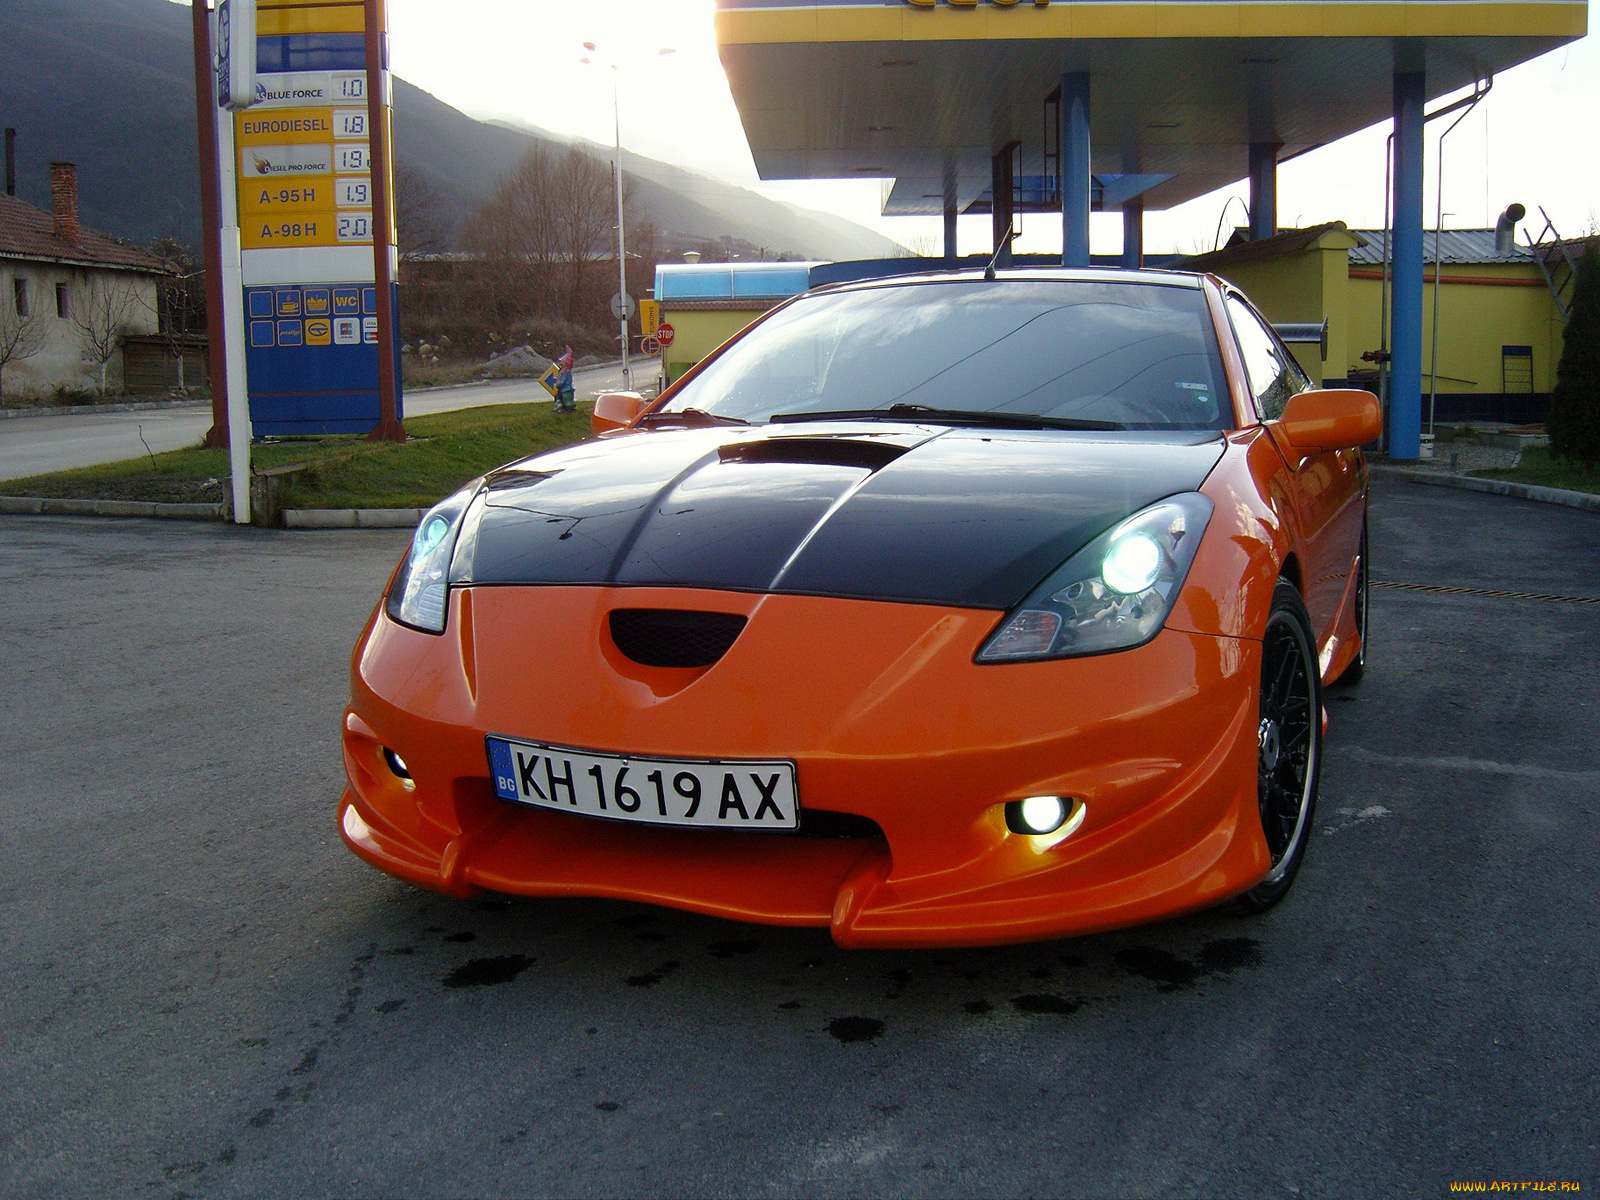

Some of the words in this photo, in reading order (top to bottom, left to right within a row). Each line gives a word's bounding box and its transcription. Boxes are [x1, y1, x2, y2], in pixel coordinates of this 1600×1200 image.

[255, 92, 266, 101] AS
[267, 91, 290, 100] BLUE
[292, 89, 323, 99] FORCE
[342, 79, 363, 97] 1.0
[244, 119, 329, 134] EURODIESEL
[259, 190, 300, 204] A-95
[303, 188, 315, 202] H
[261, 224, 301, 238] A-98
[304, 223, 317, 236] H
[335, 296, 358, 307] WC
[657, 330, 674, 339] STOP
[499, 776, 516, 792] BG
[517, 751, 577, 806] KH
[588, 764, 702, 818] 1619
[718, 772, 785, 820] AX
